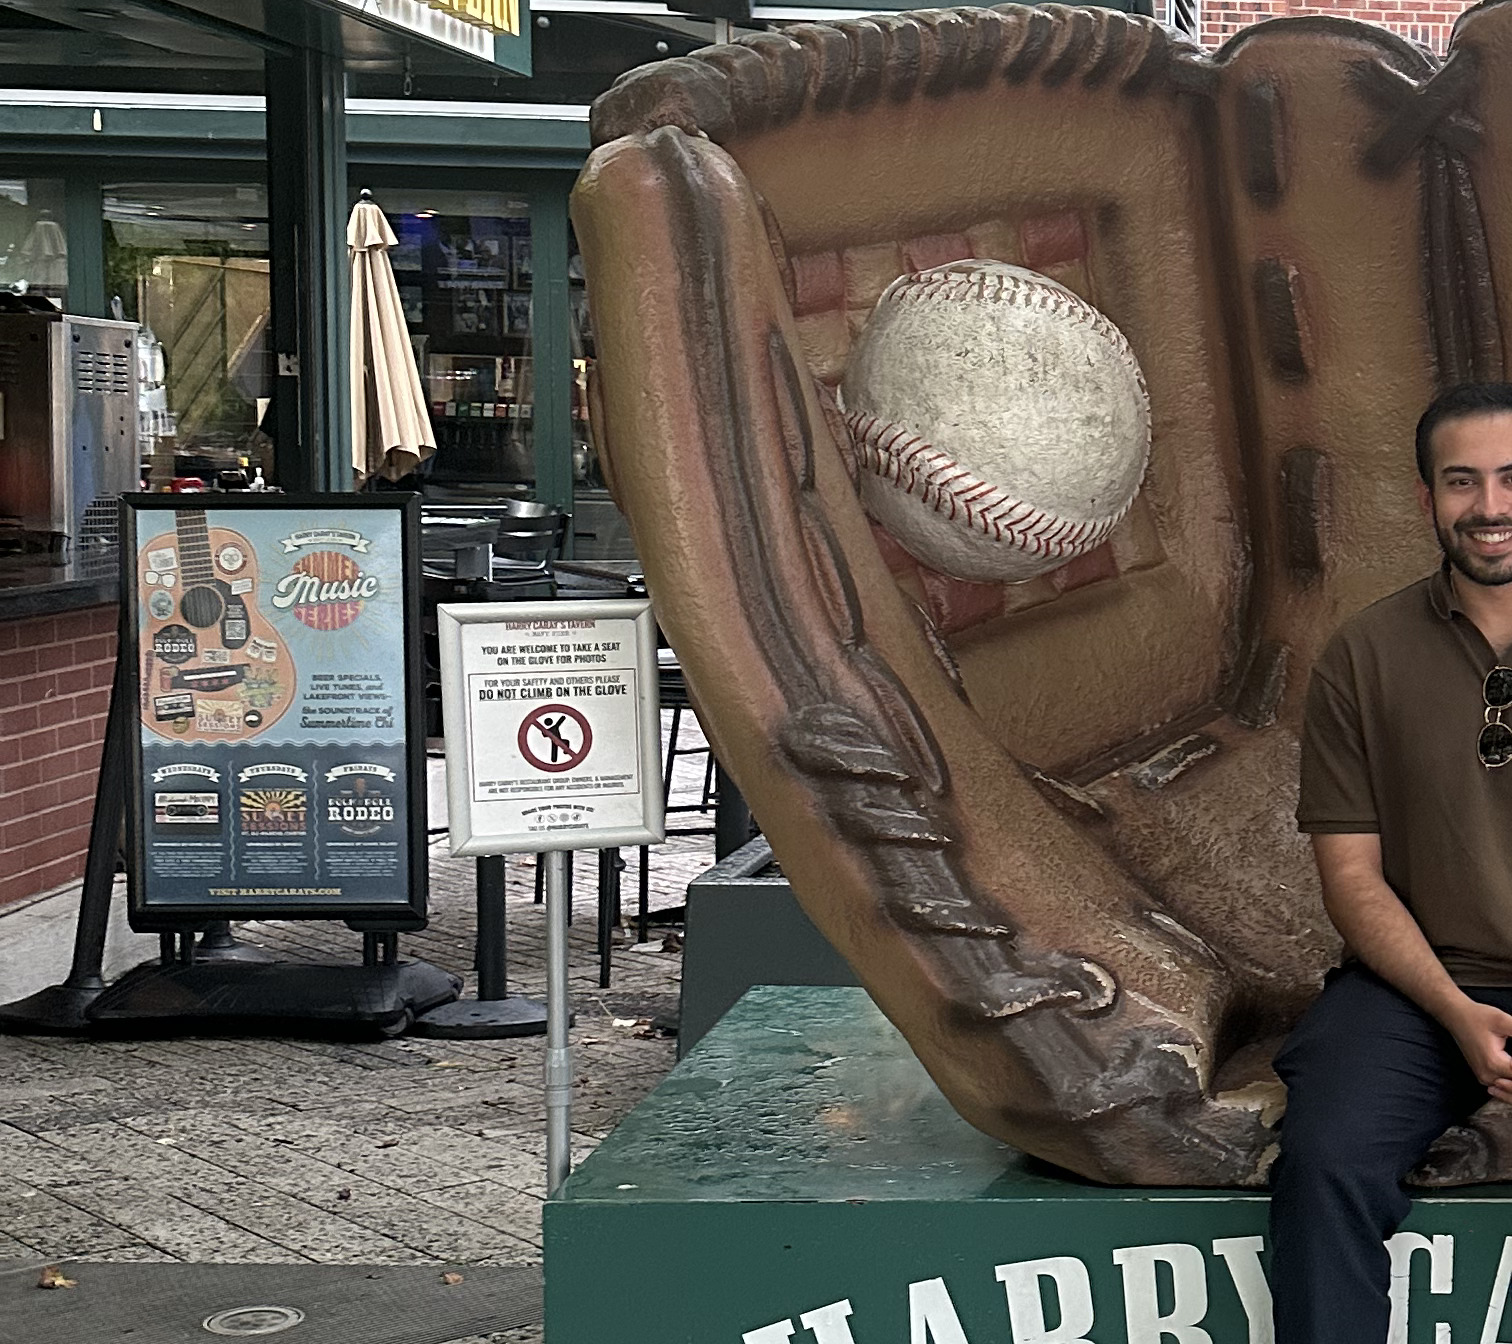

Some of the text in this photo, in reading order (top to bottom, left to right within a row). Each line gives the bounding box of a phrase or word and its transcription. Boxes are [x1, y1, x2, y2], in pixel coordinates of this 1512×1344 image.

[272, 570, 379, 609] Music
[481, 642, 621, 655] YOU ARE WELCOME TO TAKE A SEAT
[497, 654, 607, 666] ON THE GLOVE FOR PHOTOS
[484, 675, 621, 688] FOR YOUR SAFETY AND OTHERS PLEASE
[479, 684, 628, 700] DO NOT CLIMB ON THE GLOVE
[300, 716, 371, 728] Summertime
[161, 765, 212, 775] WEDNESDAYS
[249, 765, 296, 774] THURSDAYS
[343, 765, 378, 773] FRIDAYS
[328, 806, 394, 821] RODEO
